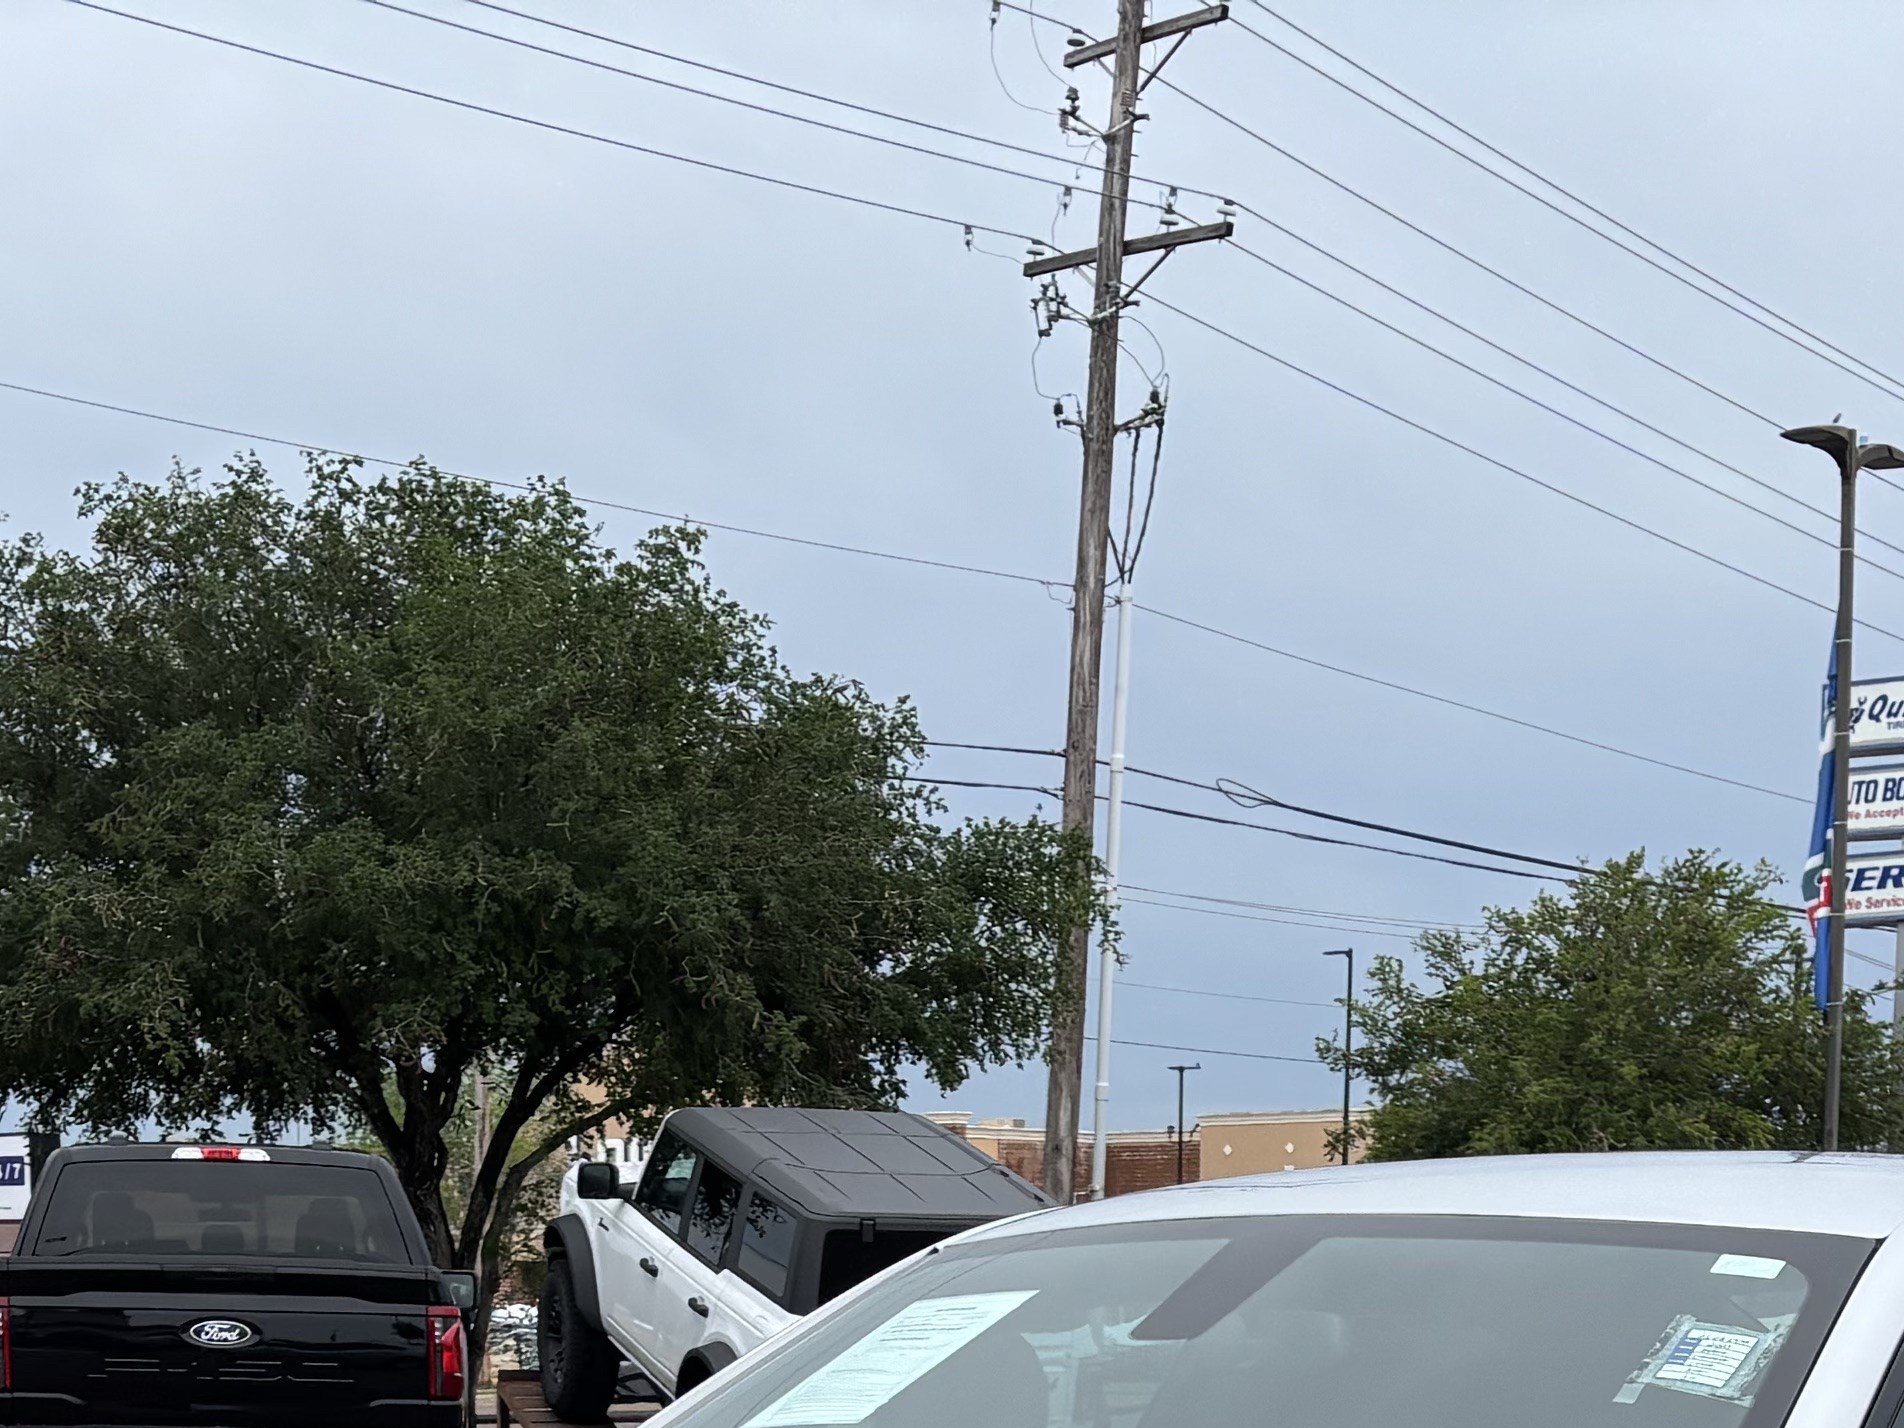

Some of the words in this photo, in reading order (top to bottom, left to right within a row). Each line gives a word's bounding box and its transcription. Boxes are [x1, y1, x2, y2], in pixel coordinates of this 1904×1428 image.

[1848, 778, 1879, 805] TO
[1864, 806, 1904, 820] Accept
[200, 1323, 241, 1342] Ford
